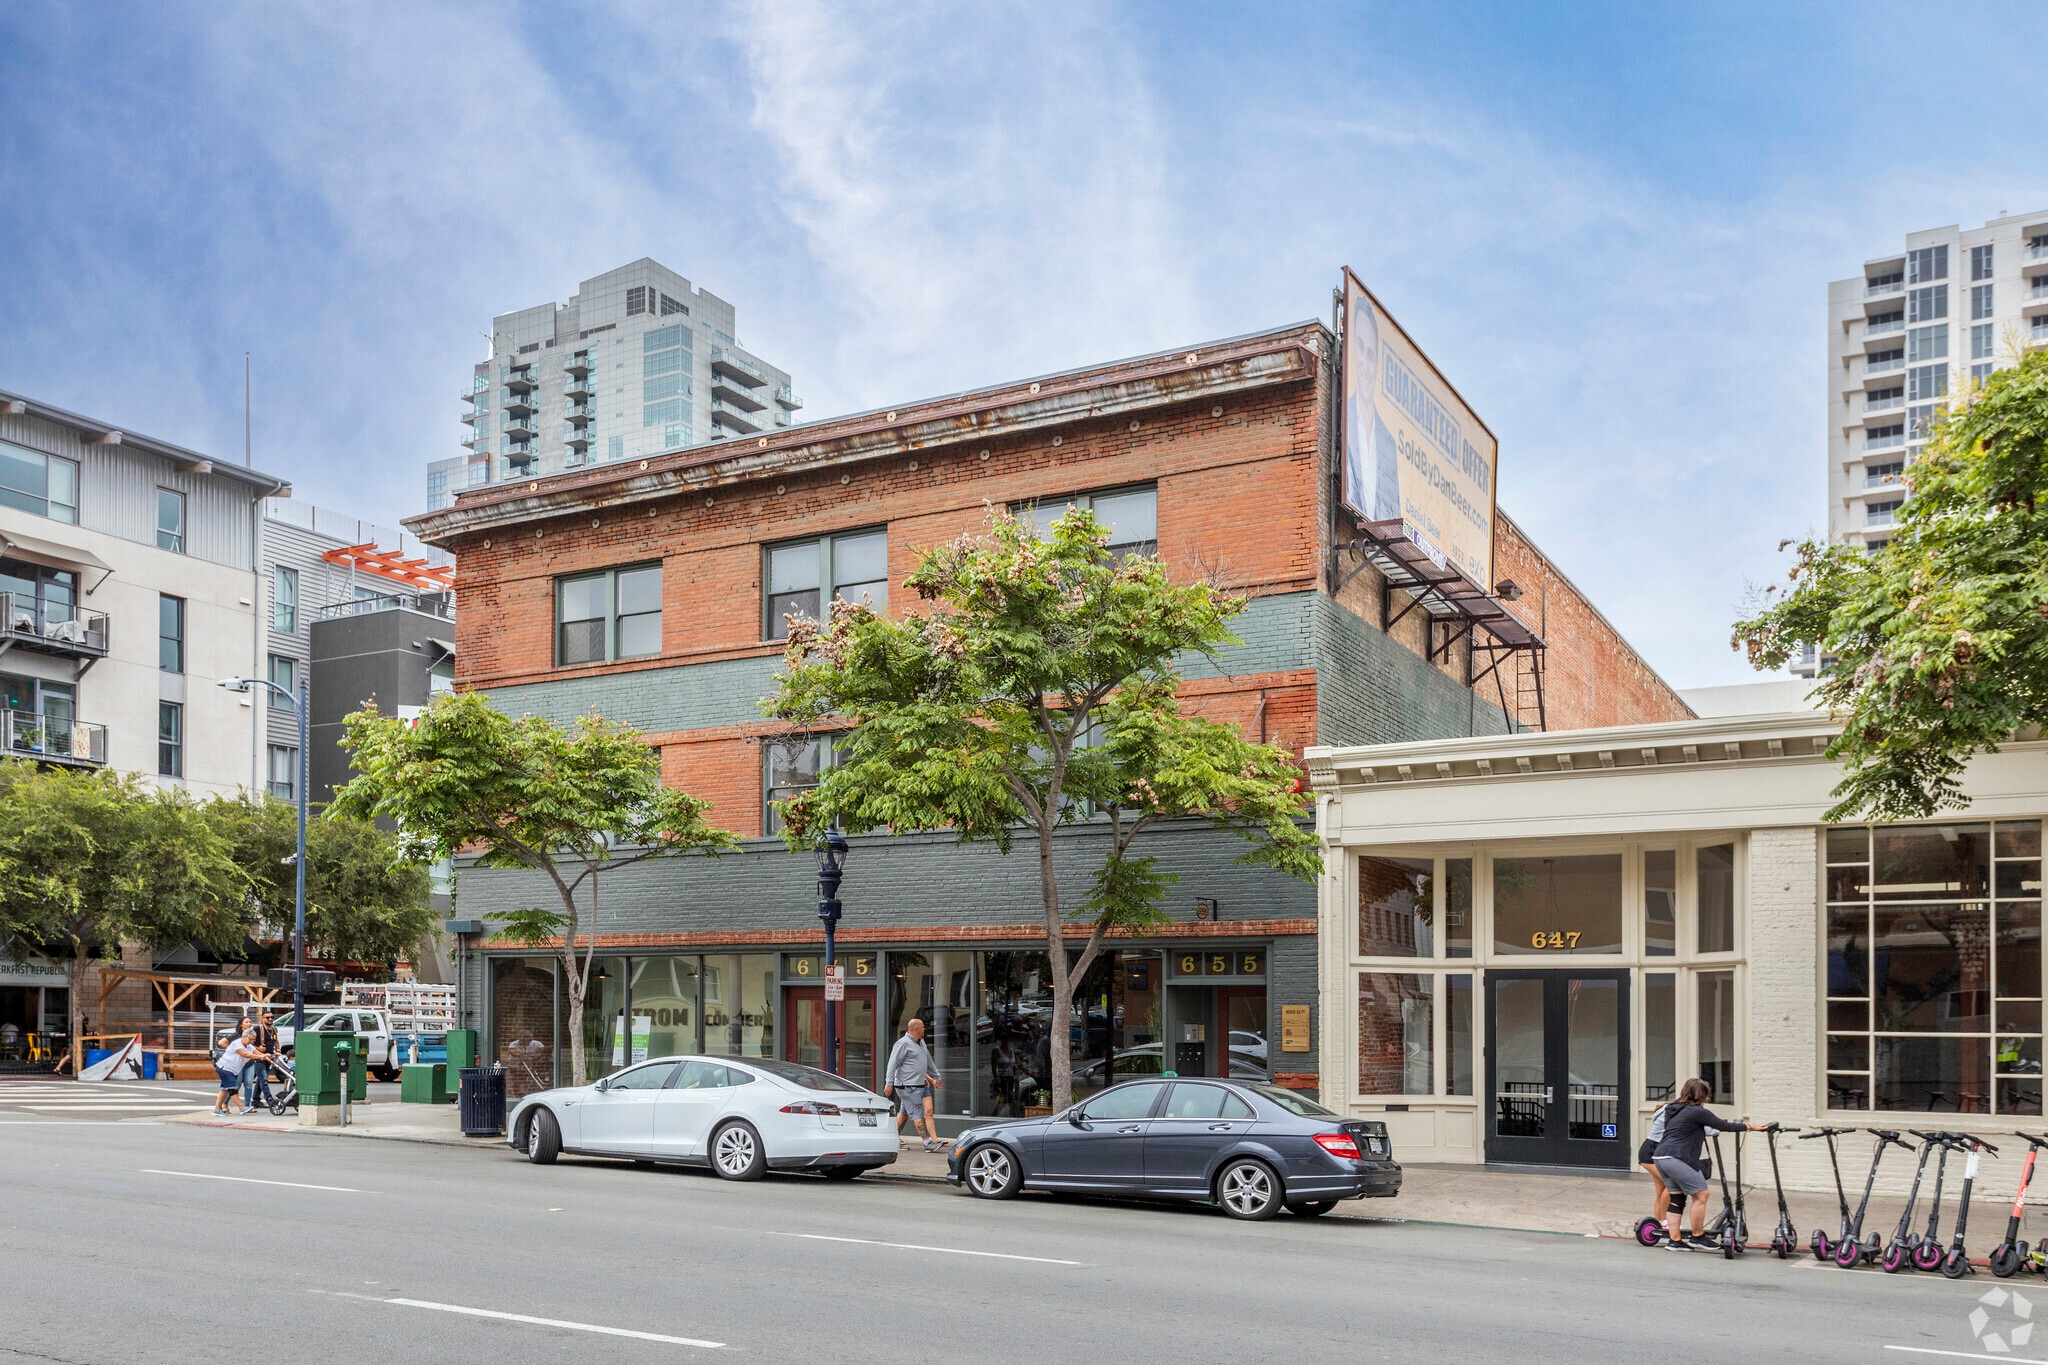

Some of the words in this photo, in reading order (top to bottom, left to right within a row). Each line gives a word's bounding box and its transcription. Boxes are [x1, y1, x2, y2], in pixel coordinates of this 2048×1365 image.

[1385, 354, 1459, 462] GUARANTEED
[1462, 438, 1490, 496] OFFER
[1398, 429, 1489, 538] SoldByDanBeer.com
[1405, 497, 1426, 529] Daniel
[1416, 532, 1444, 569] OUTFRONT
[1532, 931, 1582, 949] 647
[797, 959, 868, 975] 65
